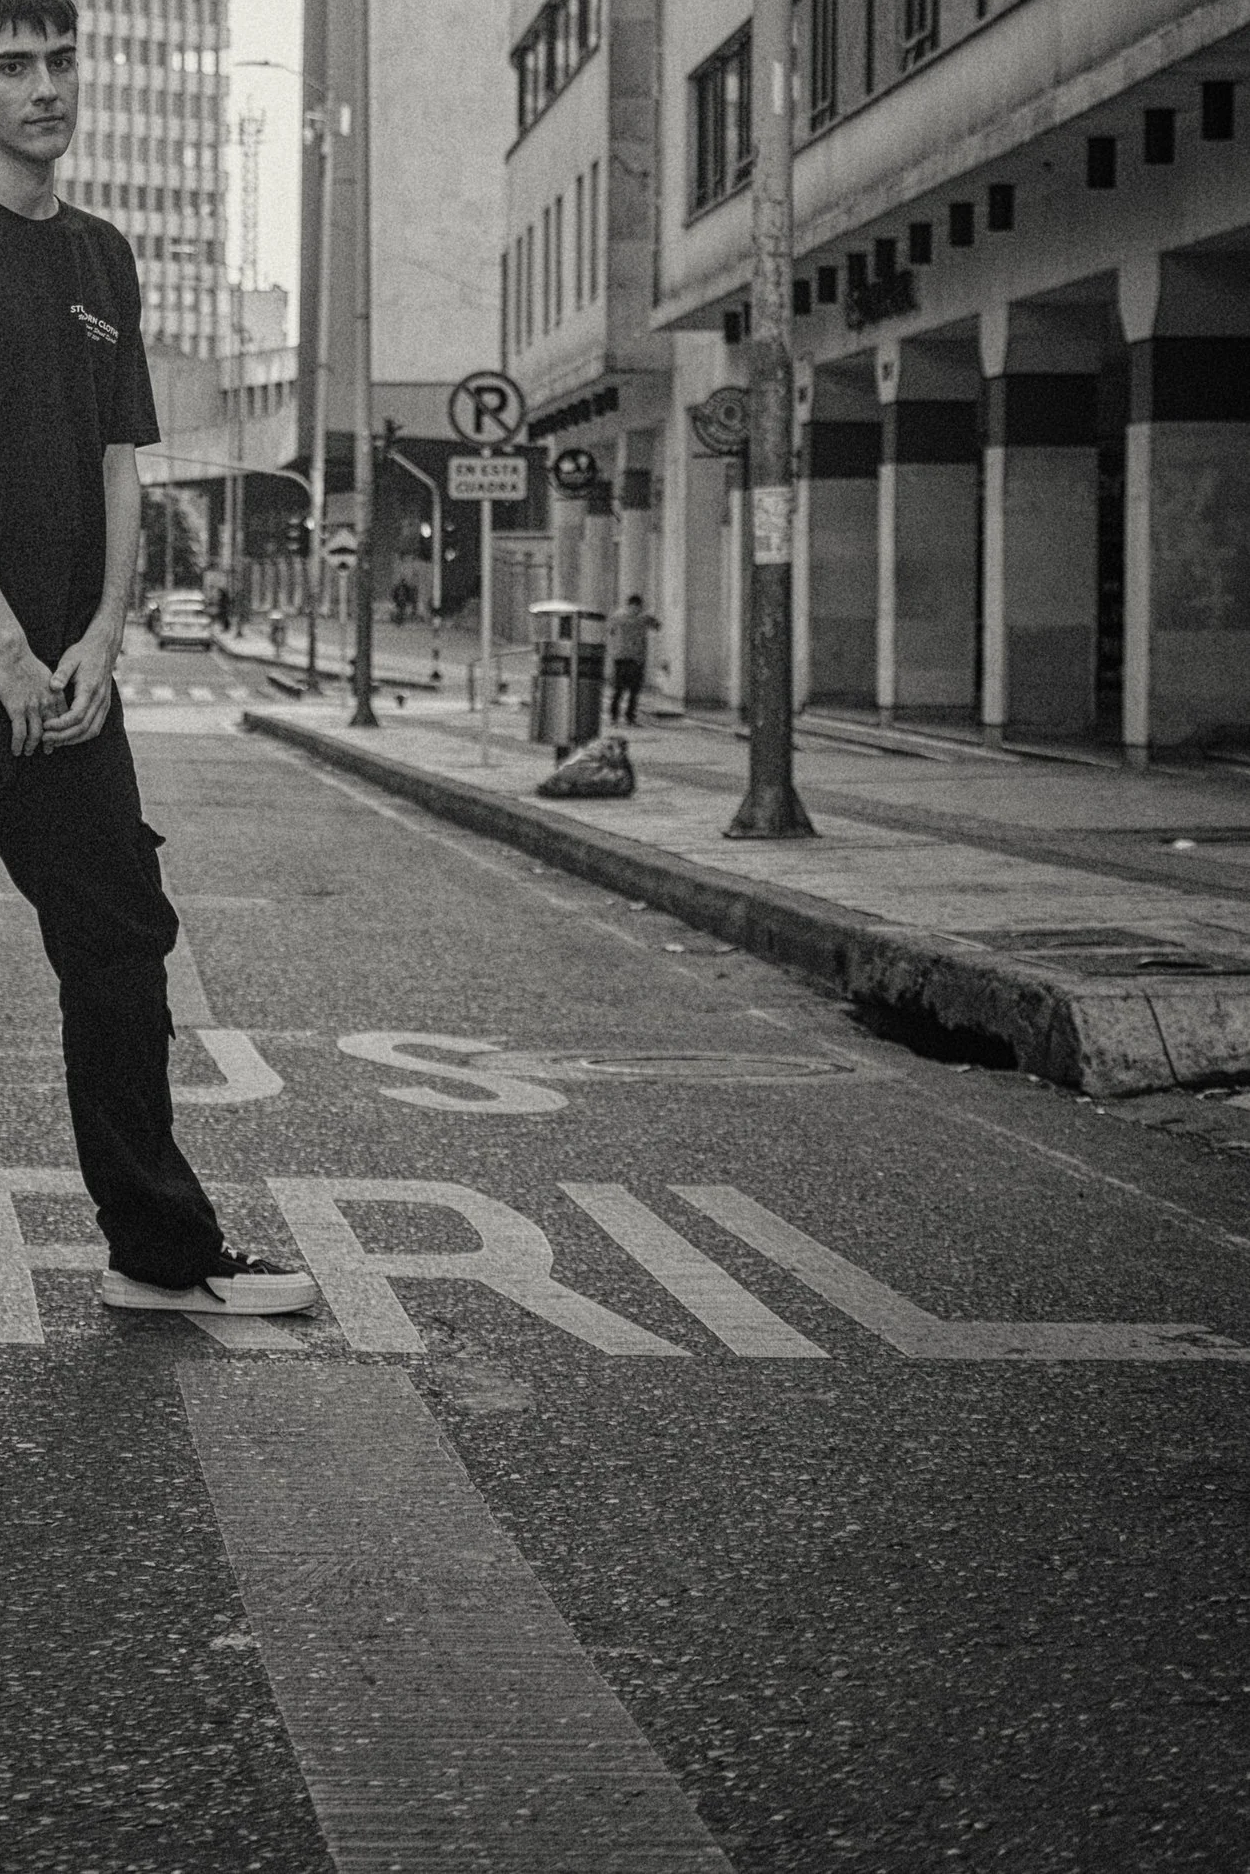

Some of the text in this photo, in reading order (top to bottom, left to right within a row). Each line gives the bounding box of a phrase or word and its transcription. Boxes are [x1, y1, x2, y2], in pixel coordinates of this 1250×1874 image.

[456, 464, 520, 478] EN ESTA
[455, 481, 519, 494] CUADRA
